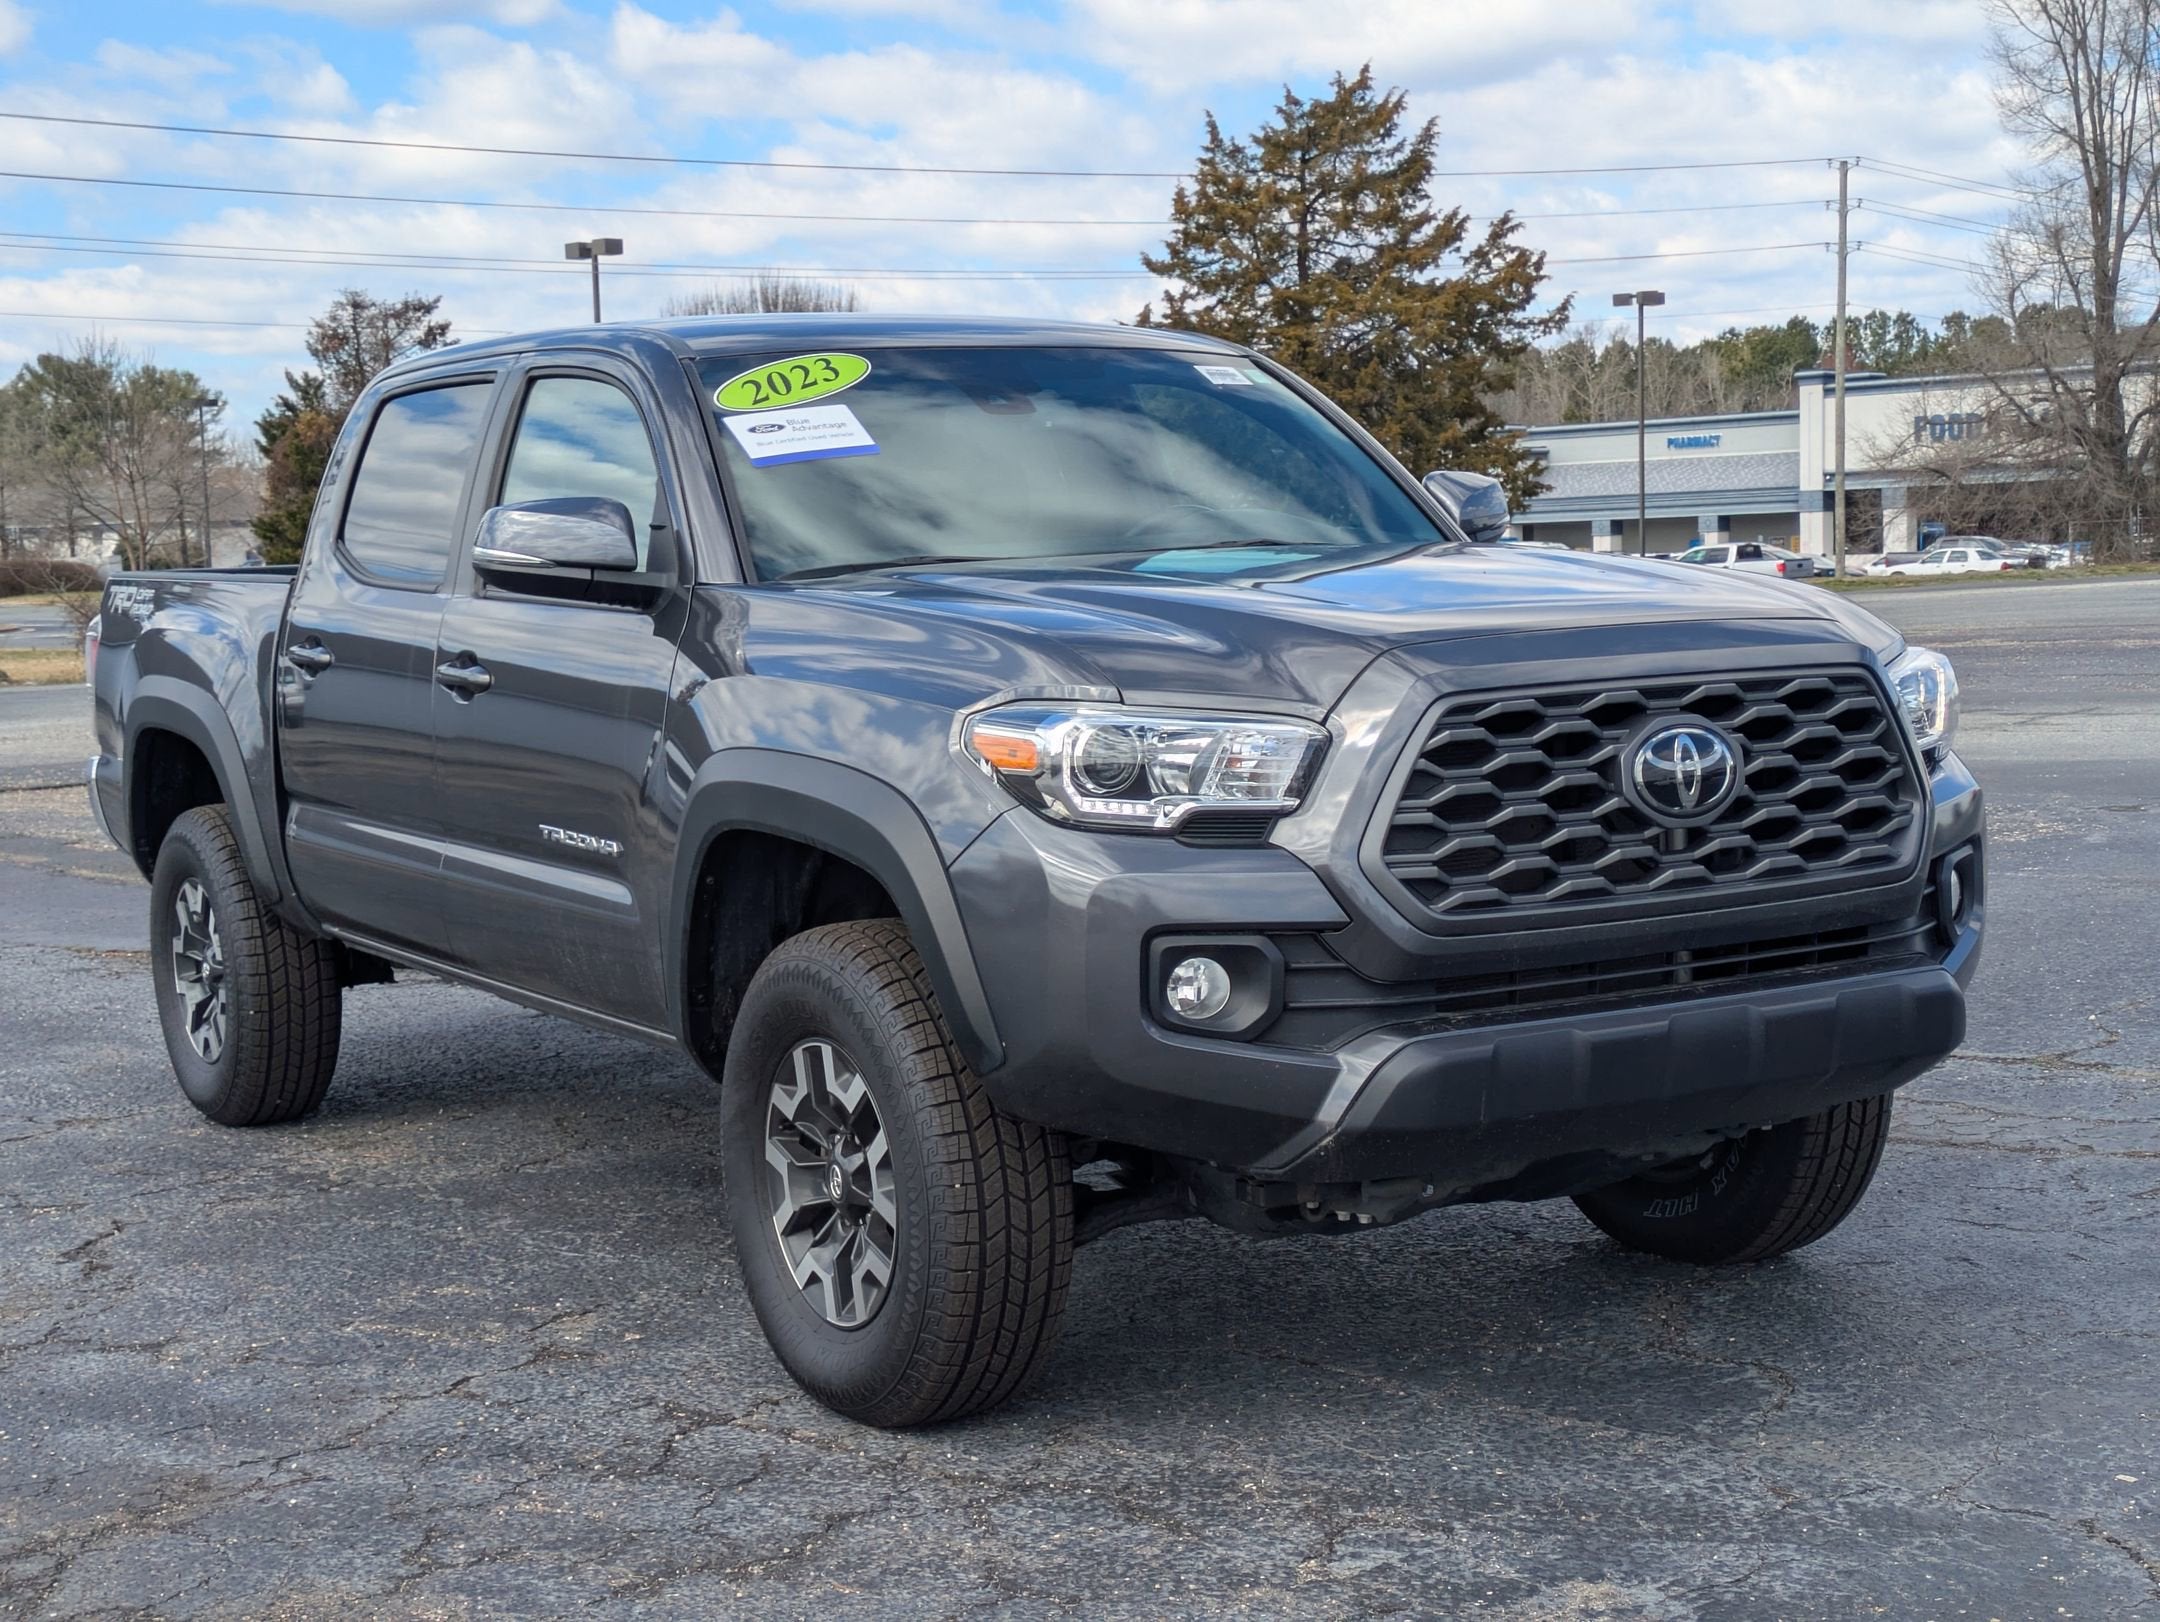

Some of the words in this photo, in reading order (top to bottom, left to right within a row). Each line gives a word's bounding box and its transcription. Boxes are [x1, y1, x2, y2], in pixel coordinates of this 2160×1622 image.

[741, 358, 840, 406] 2023
[786, 418, 810, 426] Blue
[792, 421, 848, 433] Advantage
[108, 585, 138, 614] TRD
[136, 588, 156, 601] OFF
[538, 823, 624, 858] TACOMA
